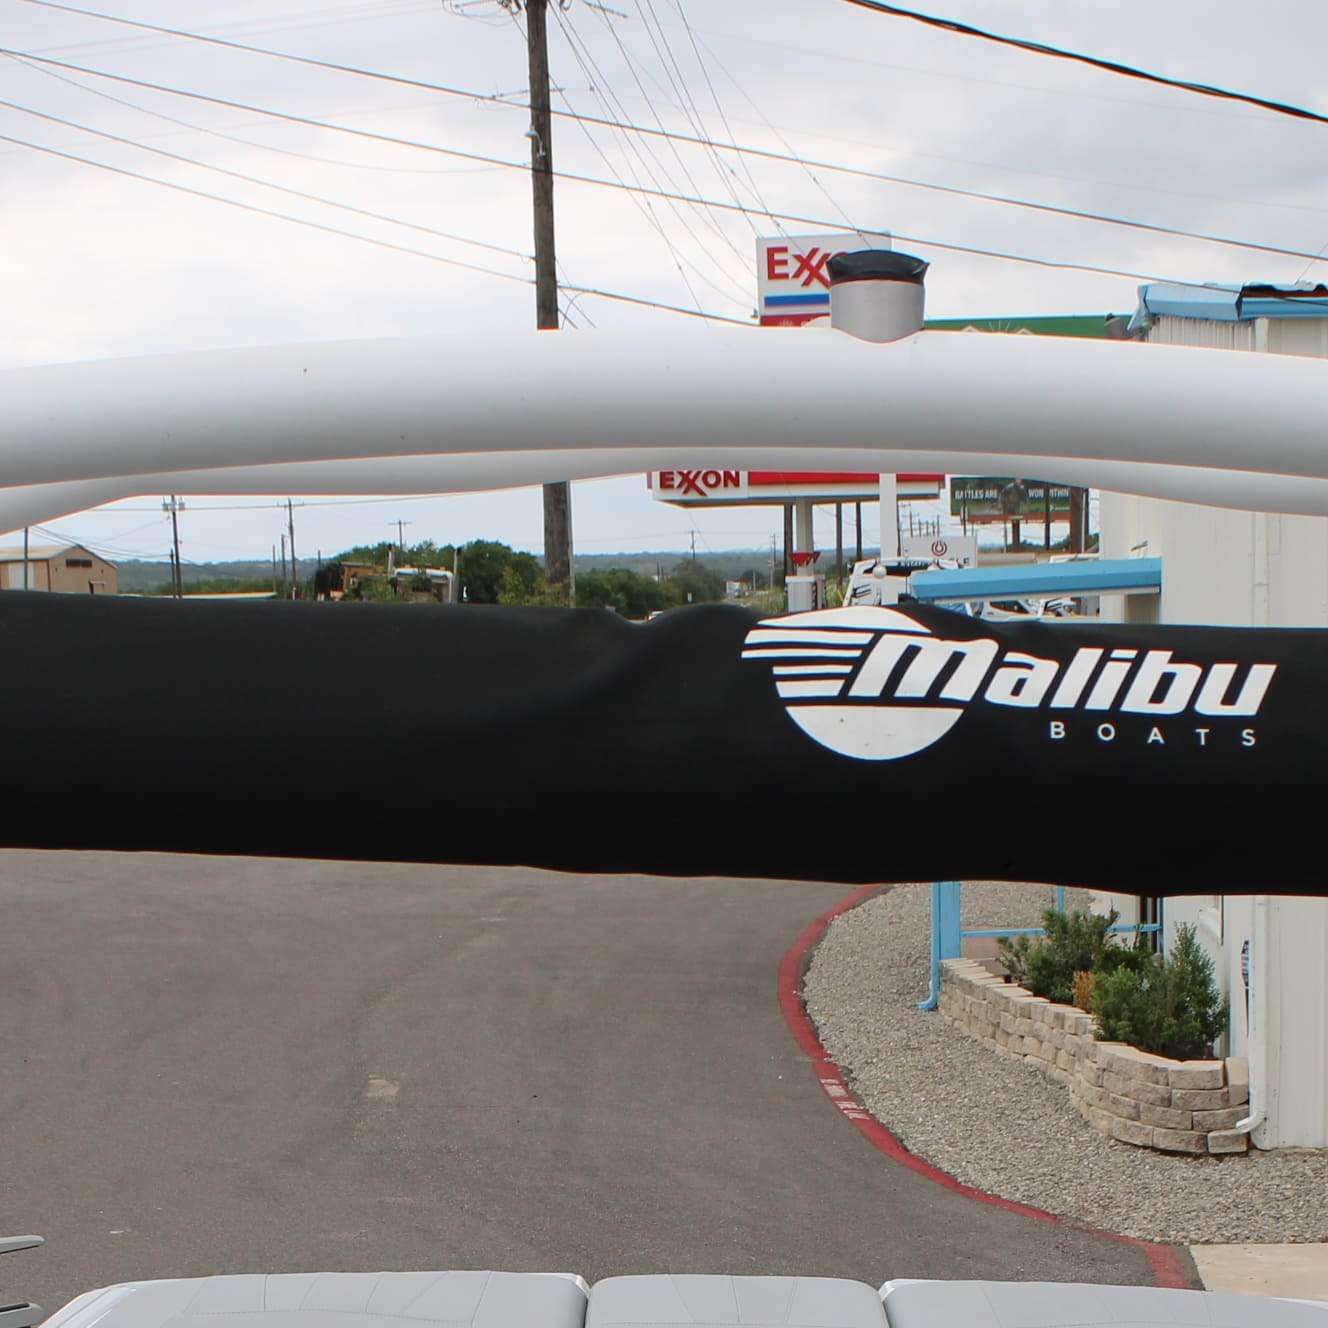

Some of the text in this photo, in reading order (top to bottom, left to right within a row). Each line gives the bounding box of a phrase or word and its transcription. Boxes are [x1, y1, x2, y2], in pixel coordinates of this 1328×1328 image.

[767, 246, 849, 290] EXX
[660, 470, 740, 496] EXXON
[1029, 488, 1044, 499] WON
[1050, 721, 1258, 746] BOATS
